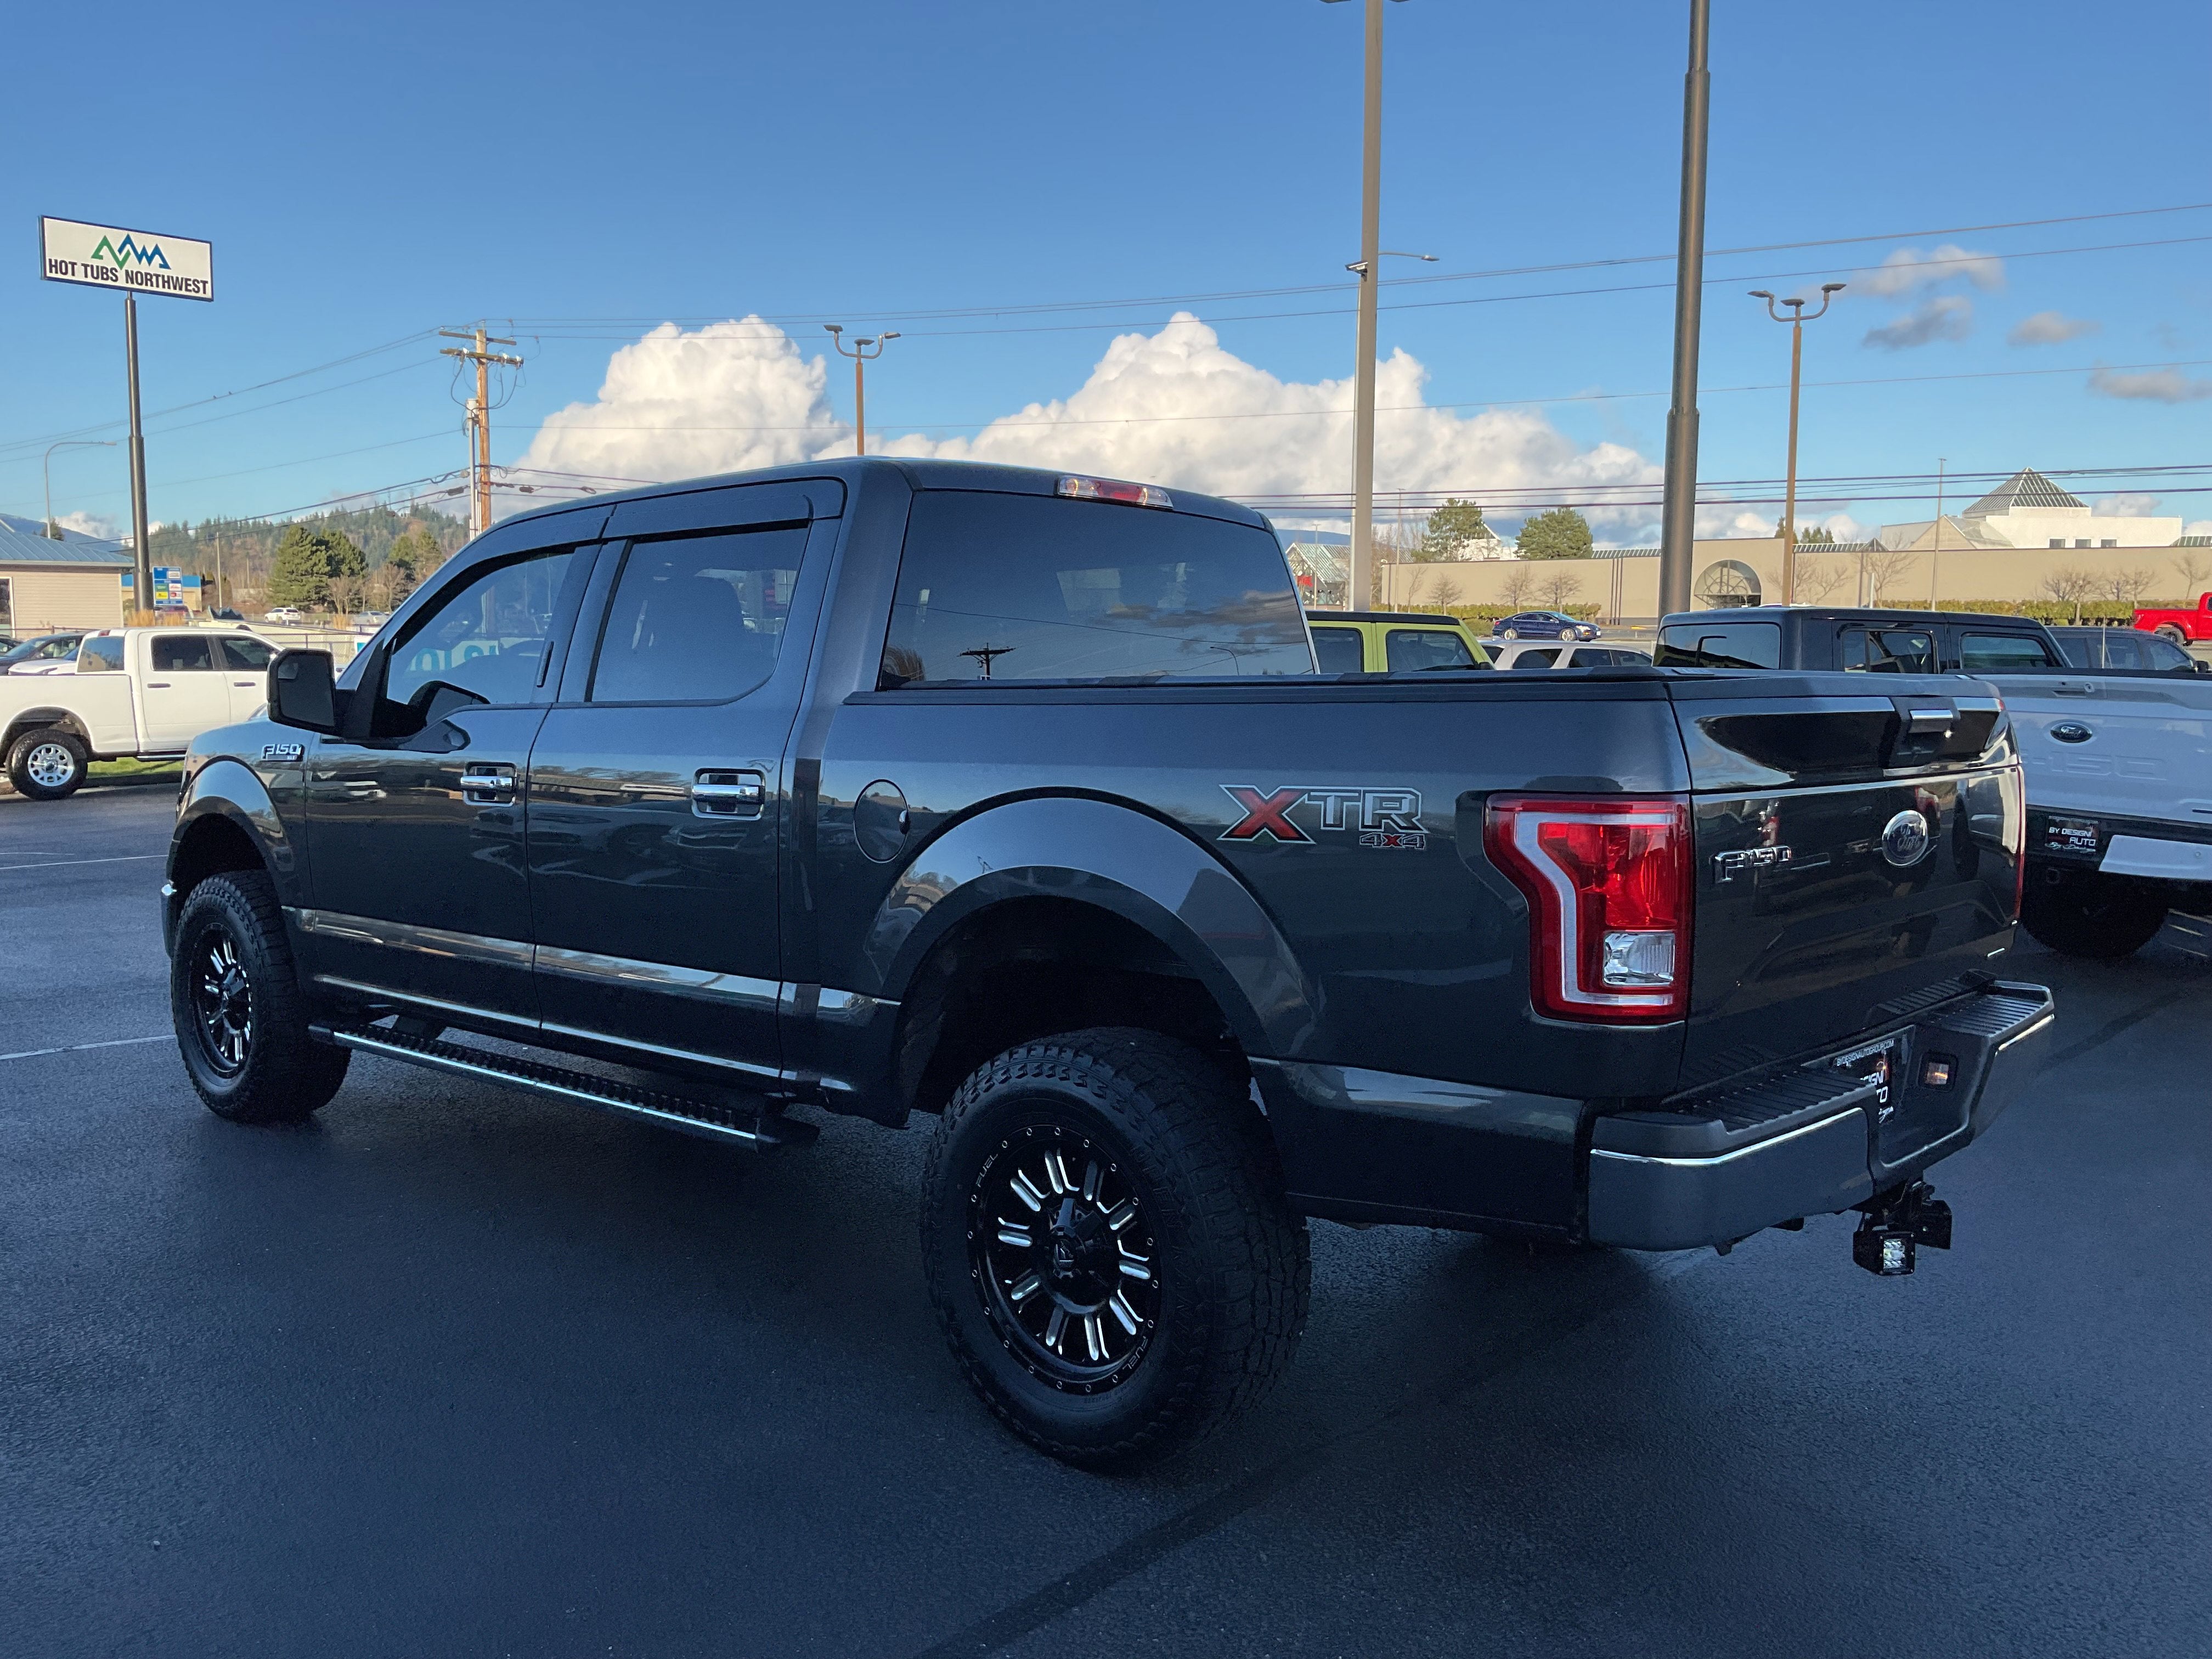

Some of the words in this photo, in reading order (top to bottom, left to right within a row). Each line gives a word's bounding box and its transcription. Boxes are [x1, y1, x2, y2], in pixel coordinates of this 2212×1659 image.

[48, 258, 77, 276] HOT
[81, 263, 119, 283] TUBS
[125, 269, 209, 295] NORTHWEST
[1217, 783, 1430, 845] XTR
[2061, 828, 2092, 837] DESIGN
[2069, 837, 2096, 847] AUTO
[976, 1153, 998, 1188] FUEL
[1122, 1336, 1148, 1370] FUEL
